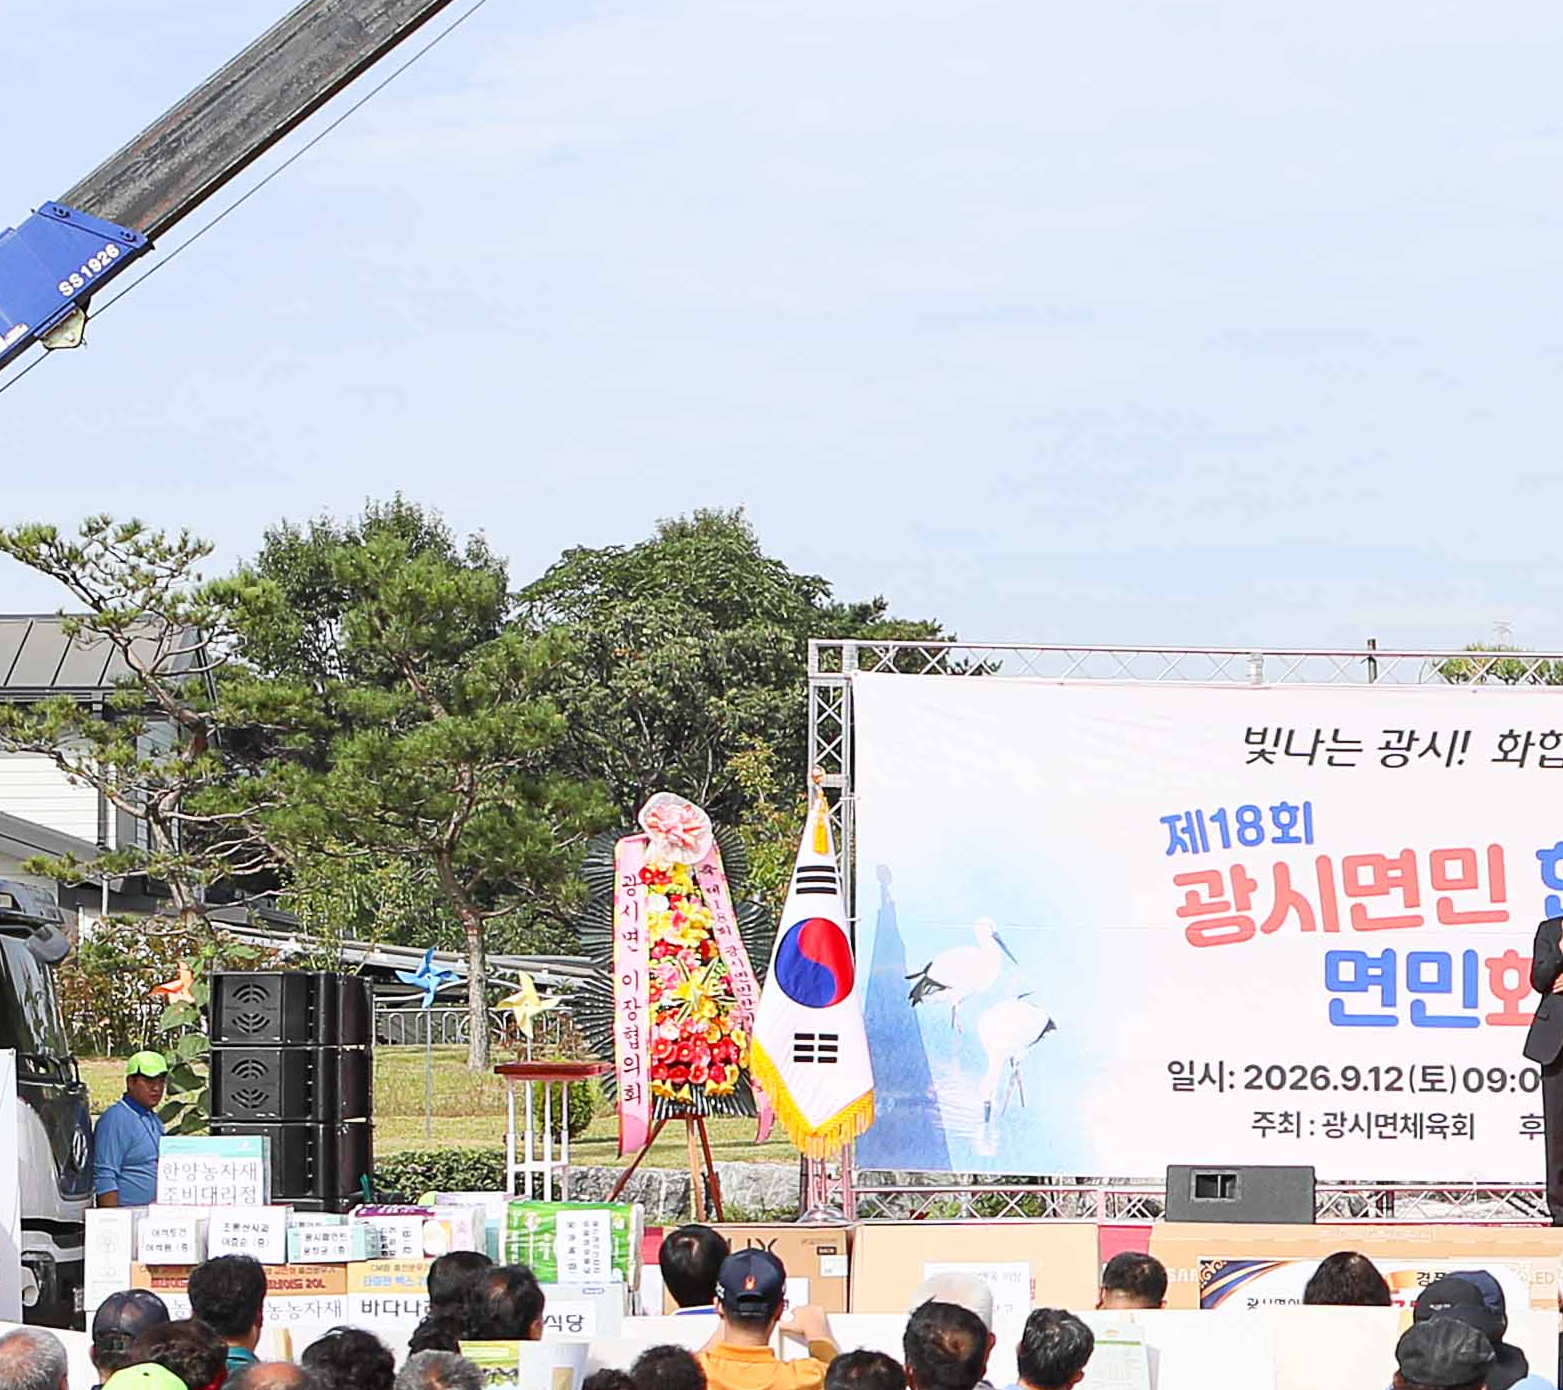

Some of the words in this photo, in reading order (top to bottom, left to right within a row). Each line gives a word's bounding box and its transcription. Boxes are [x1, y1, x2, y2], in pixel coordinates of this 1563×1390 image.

[57, 244, 120, 297] SS1926
[1244, 726, 1364, 767] 빛나는
[1376, 728, 1471, 769] 광시!
[1160, 800, 1315, 856] 제18회
[622, 875, 639, 952] 광시면
[1172, 842, 1510, 948] 광시면민
[1167, 1060, 1235, 1094] 일시:
[1321, 1110, 1477, 1141] 광시면체육회
